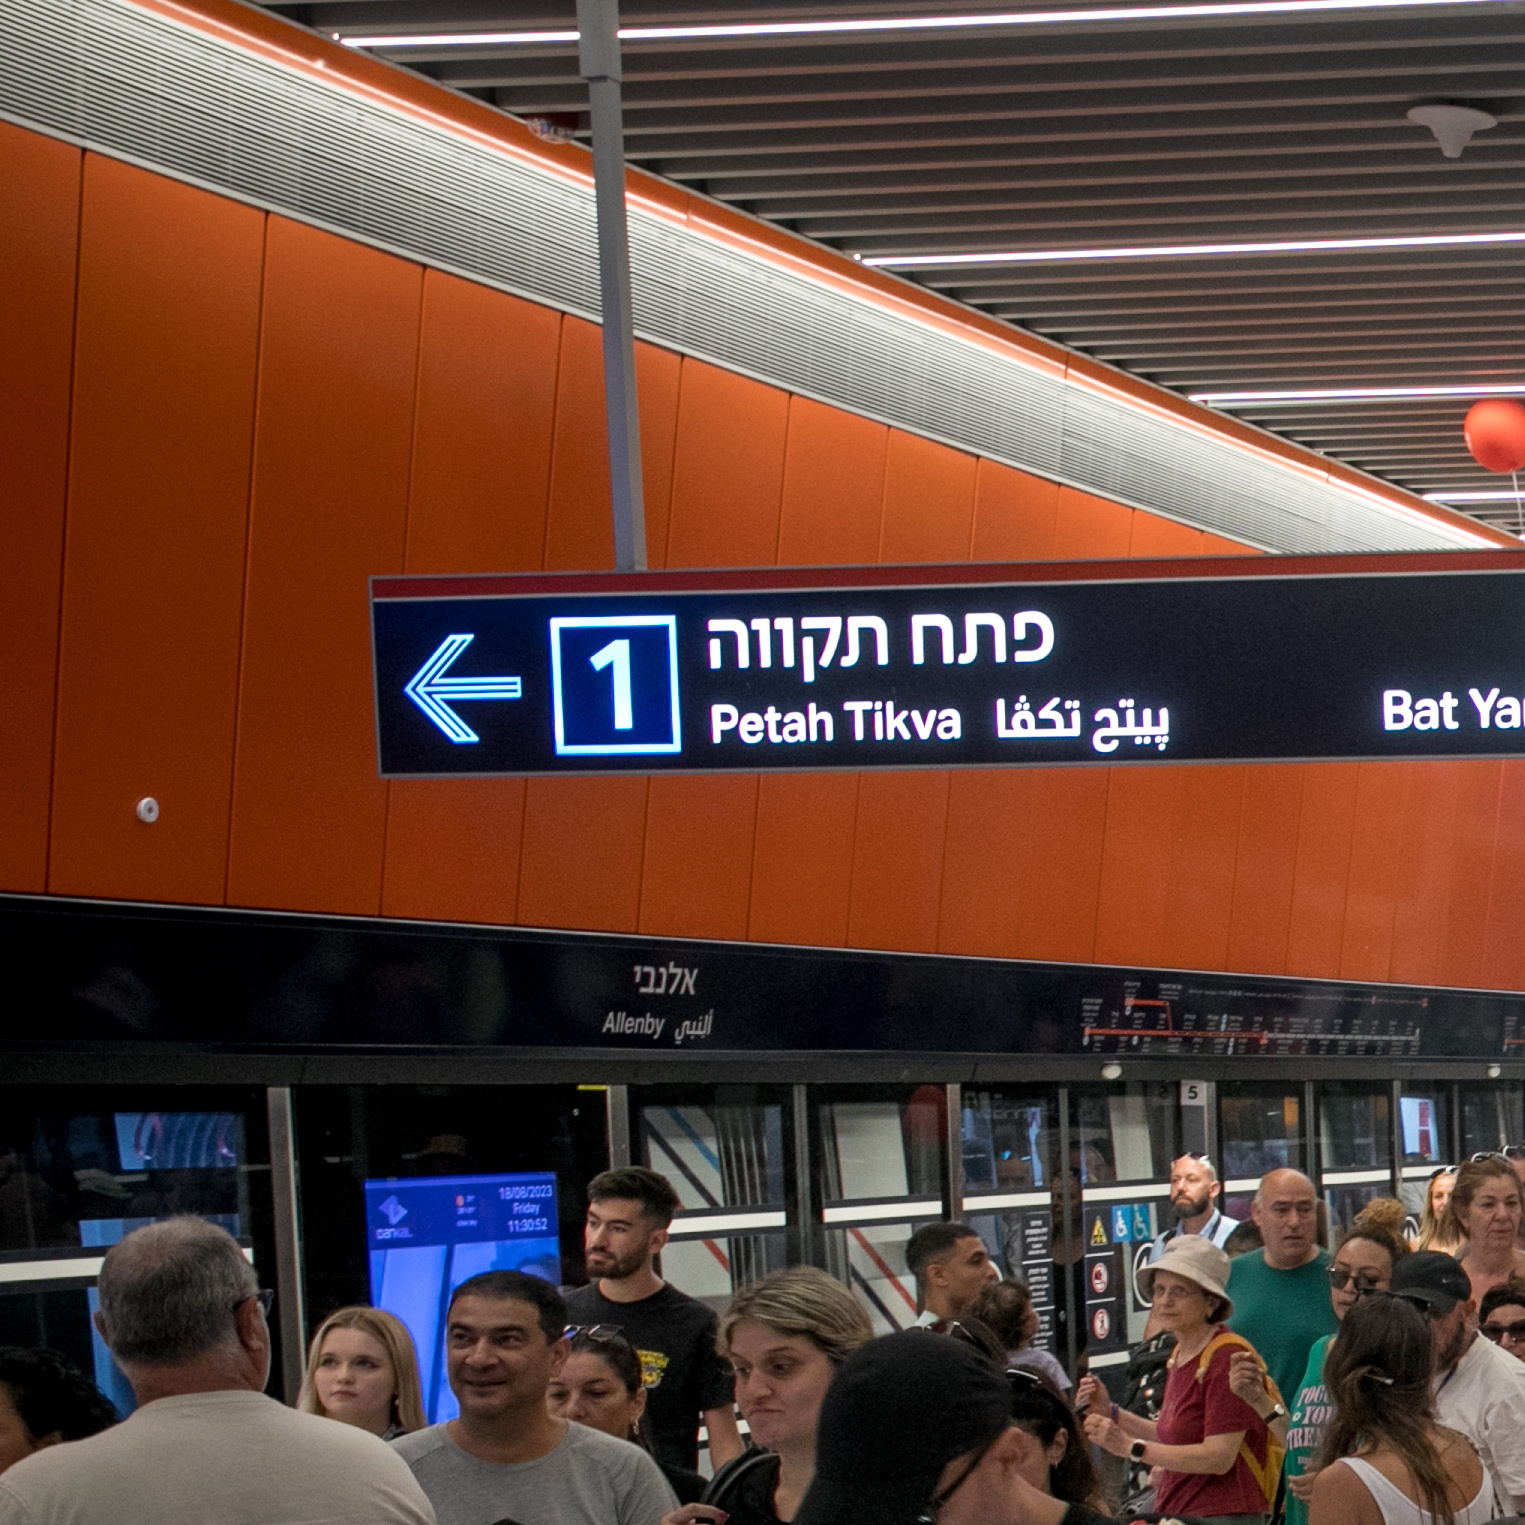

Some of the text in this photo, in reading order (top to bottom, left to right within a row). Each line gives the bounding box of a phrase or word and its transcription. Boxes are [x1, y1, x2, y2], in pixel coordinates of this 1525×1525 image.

[708, 610, 1055, 683] פתח תקווה
[589, 638, 633, 730] 1
[711, 700, 962, 744] Petah Tikva
[1382, 688, 1460, 732] Bat
[633, 961, 698, 995] אלנבי
[602, 1010, 665, 1040] Allenby
[1187, 1085, 1198, 1100] 5
[499, 1184, 553, 1201] 18/08/2023
[512, 1201, 541, 1216] Friday
[507, 1217, 548, 1233] 11:30:52
